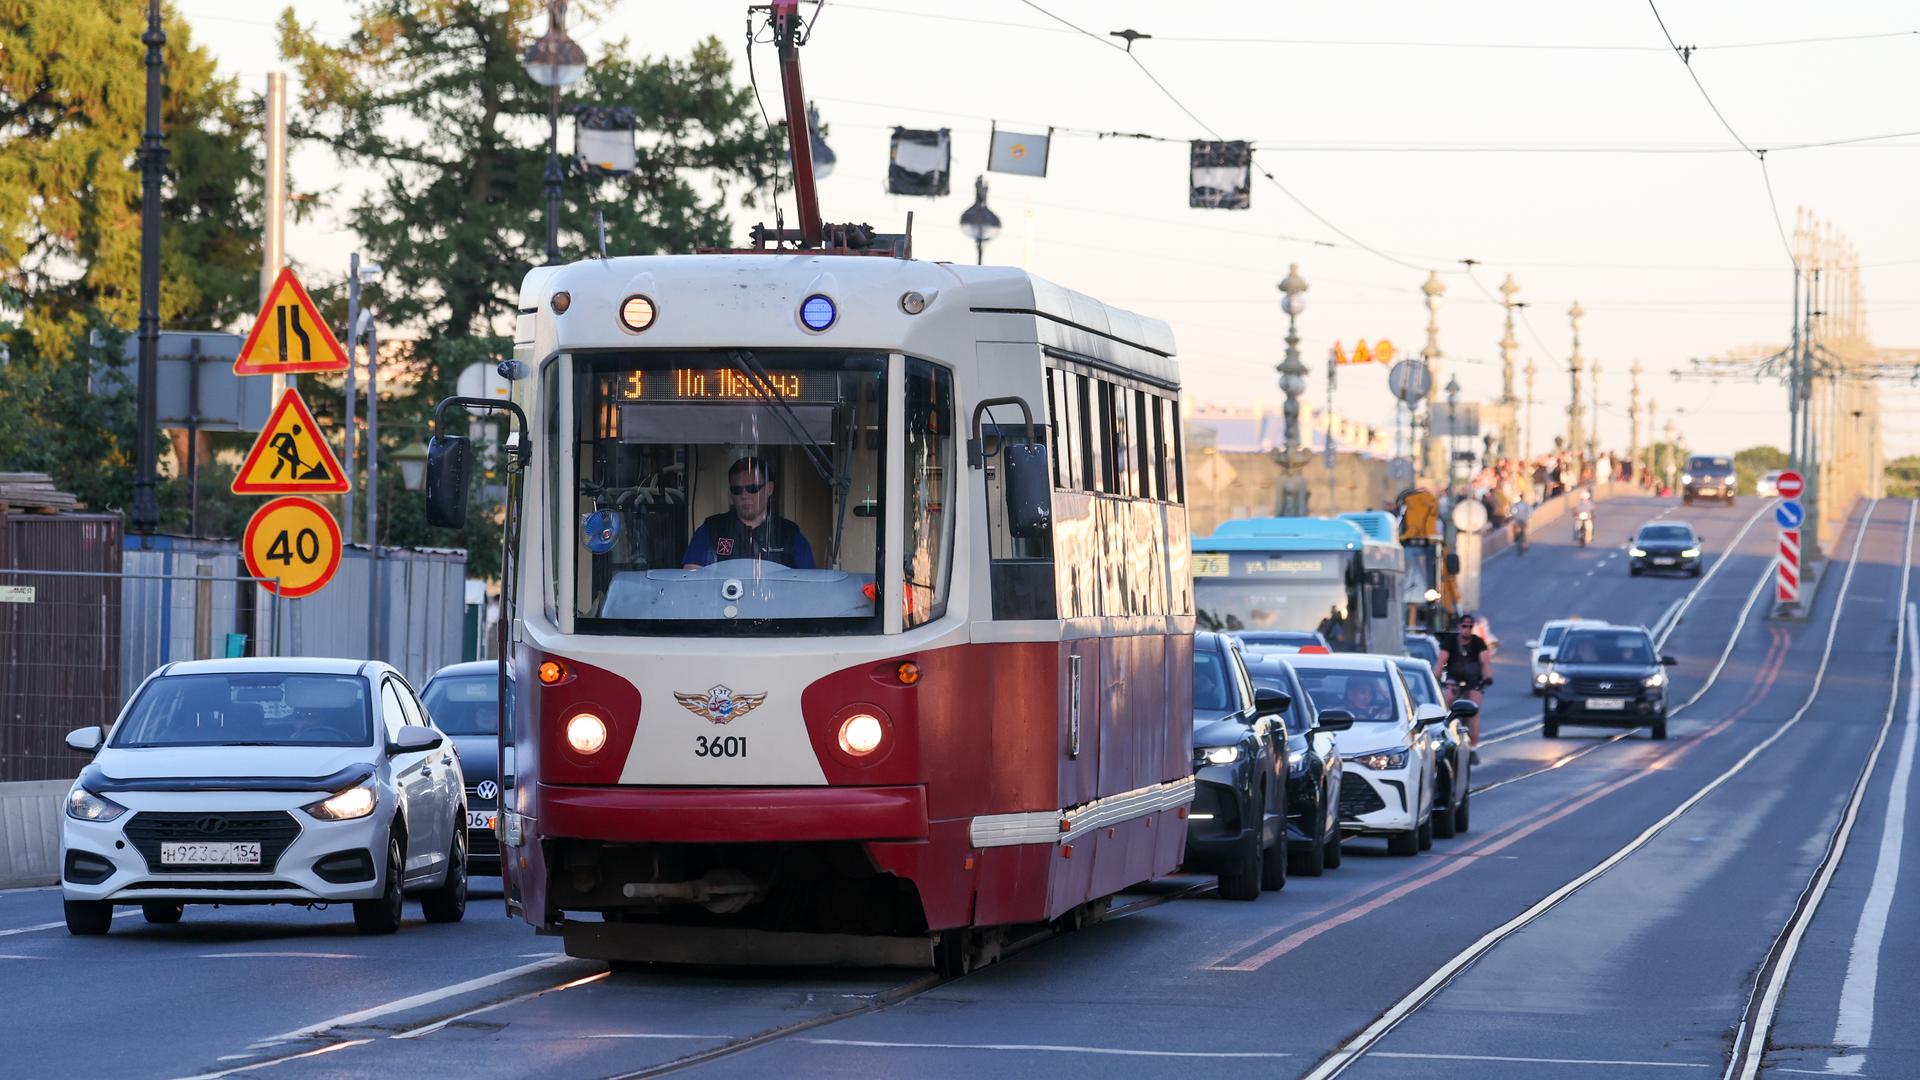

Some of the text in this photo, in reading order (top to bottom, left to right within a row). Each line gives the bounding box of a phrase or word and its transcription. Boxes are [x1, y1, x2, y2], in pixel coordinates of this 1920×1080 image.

[625, 370, 642, 398] 3
[266, 528, 320, 566] 40
[1200, 559, 1220, 573] 76
[694, 735, 746, 758] 3601
[233, 845, 258, 857] 154
